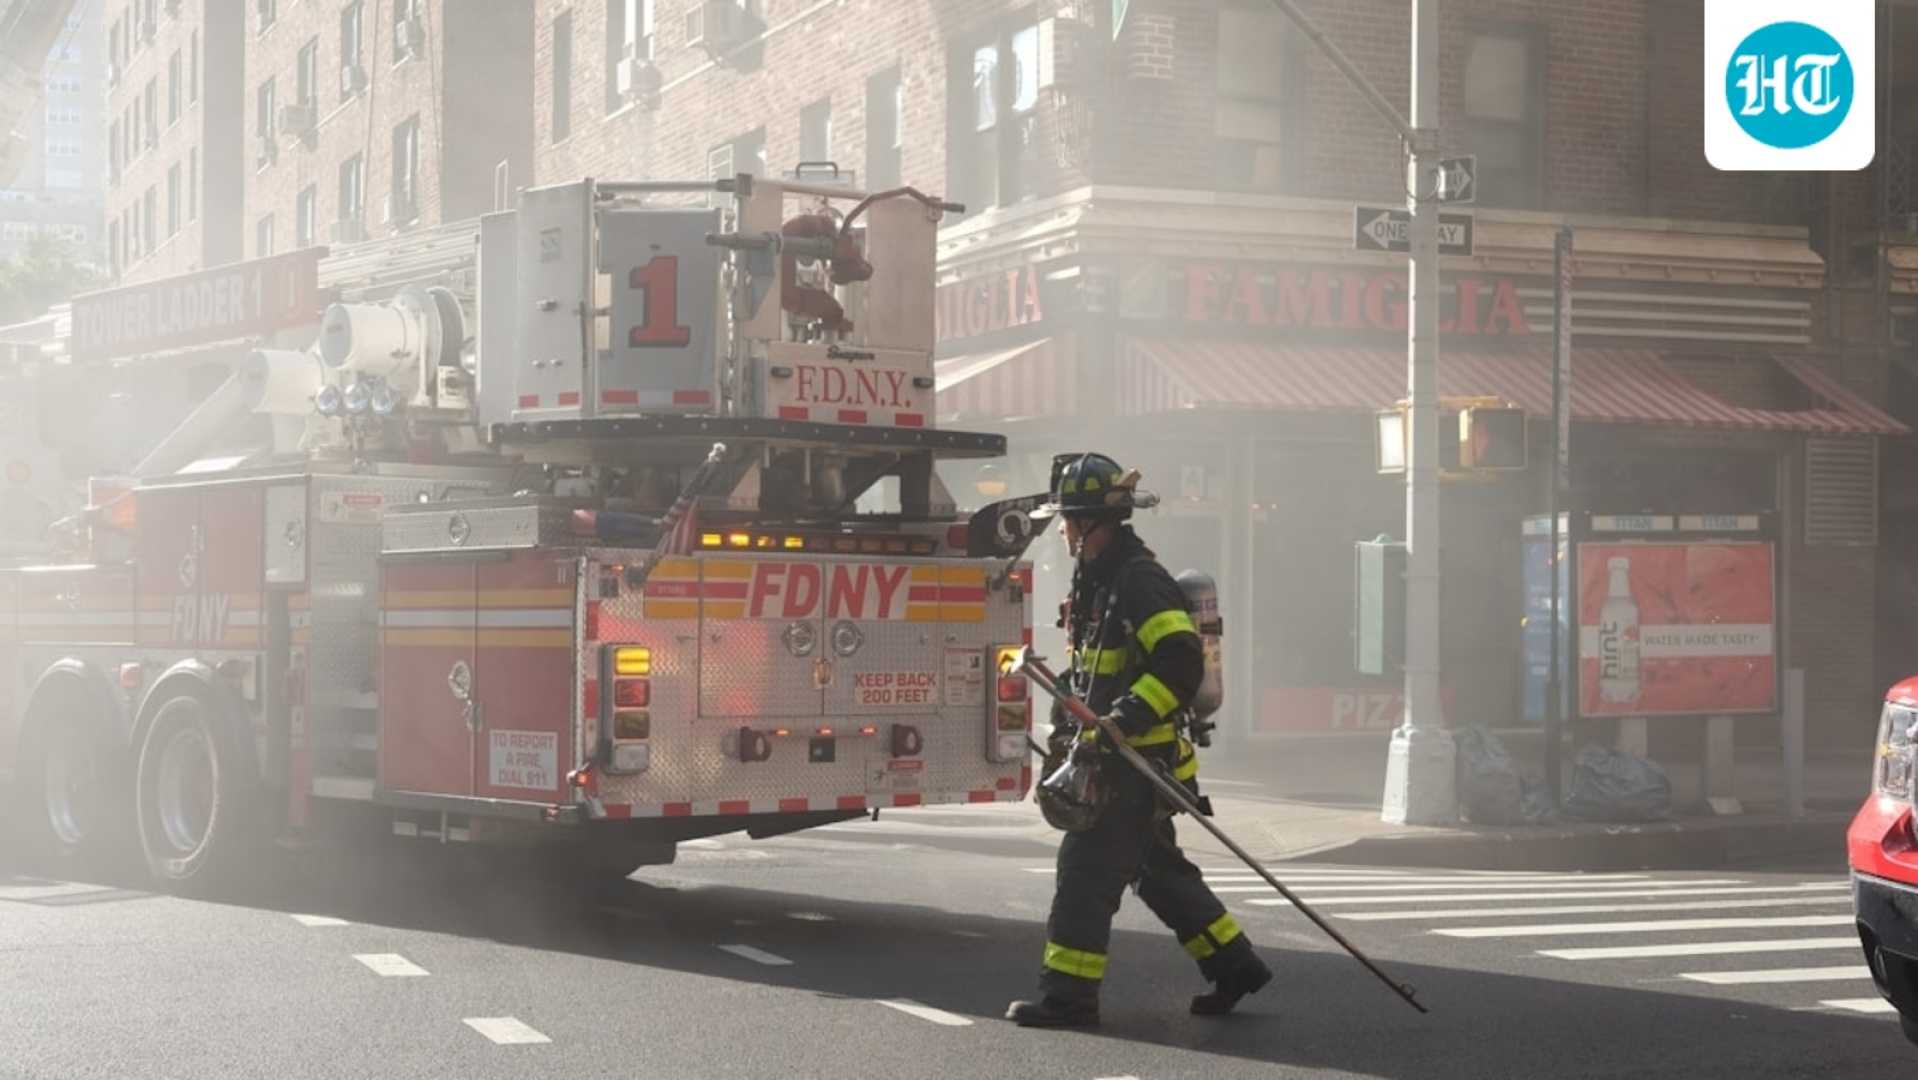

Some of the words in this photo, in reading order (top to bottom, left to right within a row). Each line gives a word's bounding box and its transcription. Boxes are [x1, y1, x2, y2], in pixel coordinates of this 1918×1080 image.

[1374, 220, 1409, 241] ONE
[1437, 224, 1458, 242] AY
[74, 293, 151, 352] TOWER
[157, 273, 243, 335] LADDER
[629, 256, 691, 348] 1
[1186, 258, 1531, 334] FAMIGIA
[795, 364, 912, 408] F.D.N.Y.
[750, 562, 909, 618] FDNY
[171, 592, 231, 641] FDNY
[1600, 620, 1617, 679] hint
[1644, 633, 1680, 646] WATER
[1685, 633, 1715, 645] MADE
[855, 672, 893, 687] KEEP
[896, 672, 937, 687] BACK
[862, 689, 892, 704] 200
[896, 689, 930, 703] FEET
[493, 732, 507, 747] TO
[510, 733, 554, 749] REPORT
[505, 751, 514, 766] A
[498, 767, 524, 785] DIAL
[527, 770, 549, 787] 911
